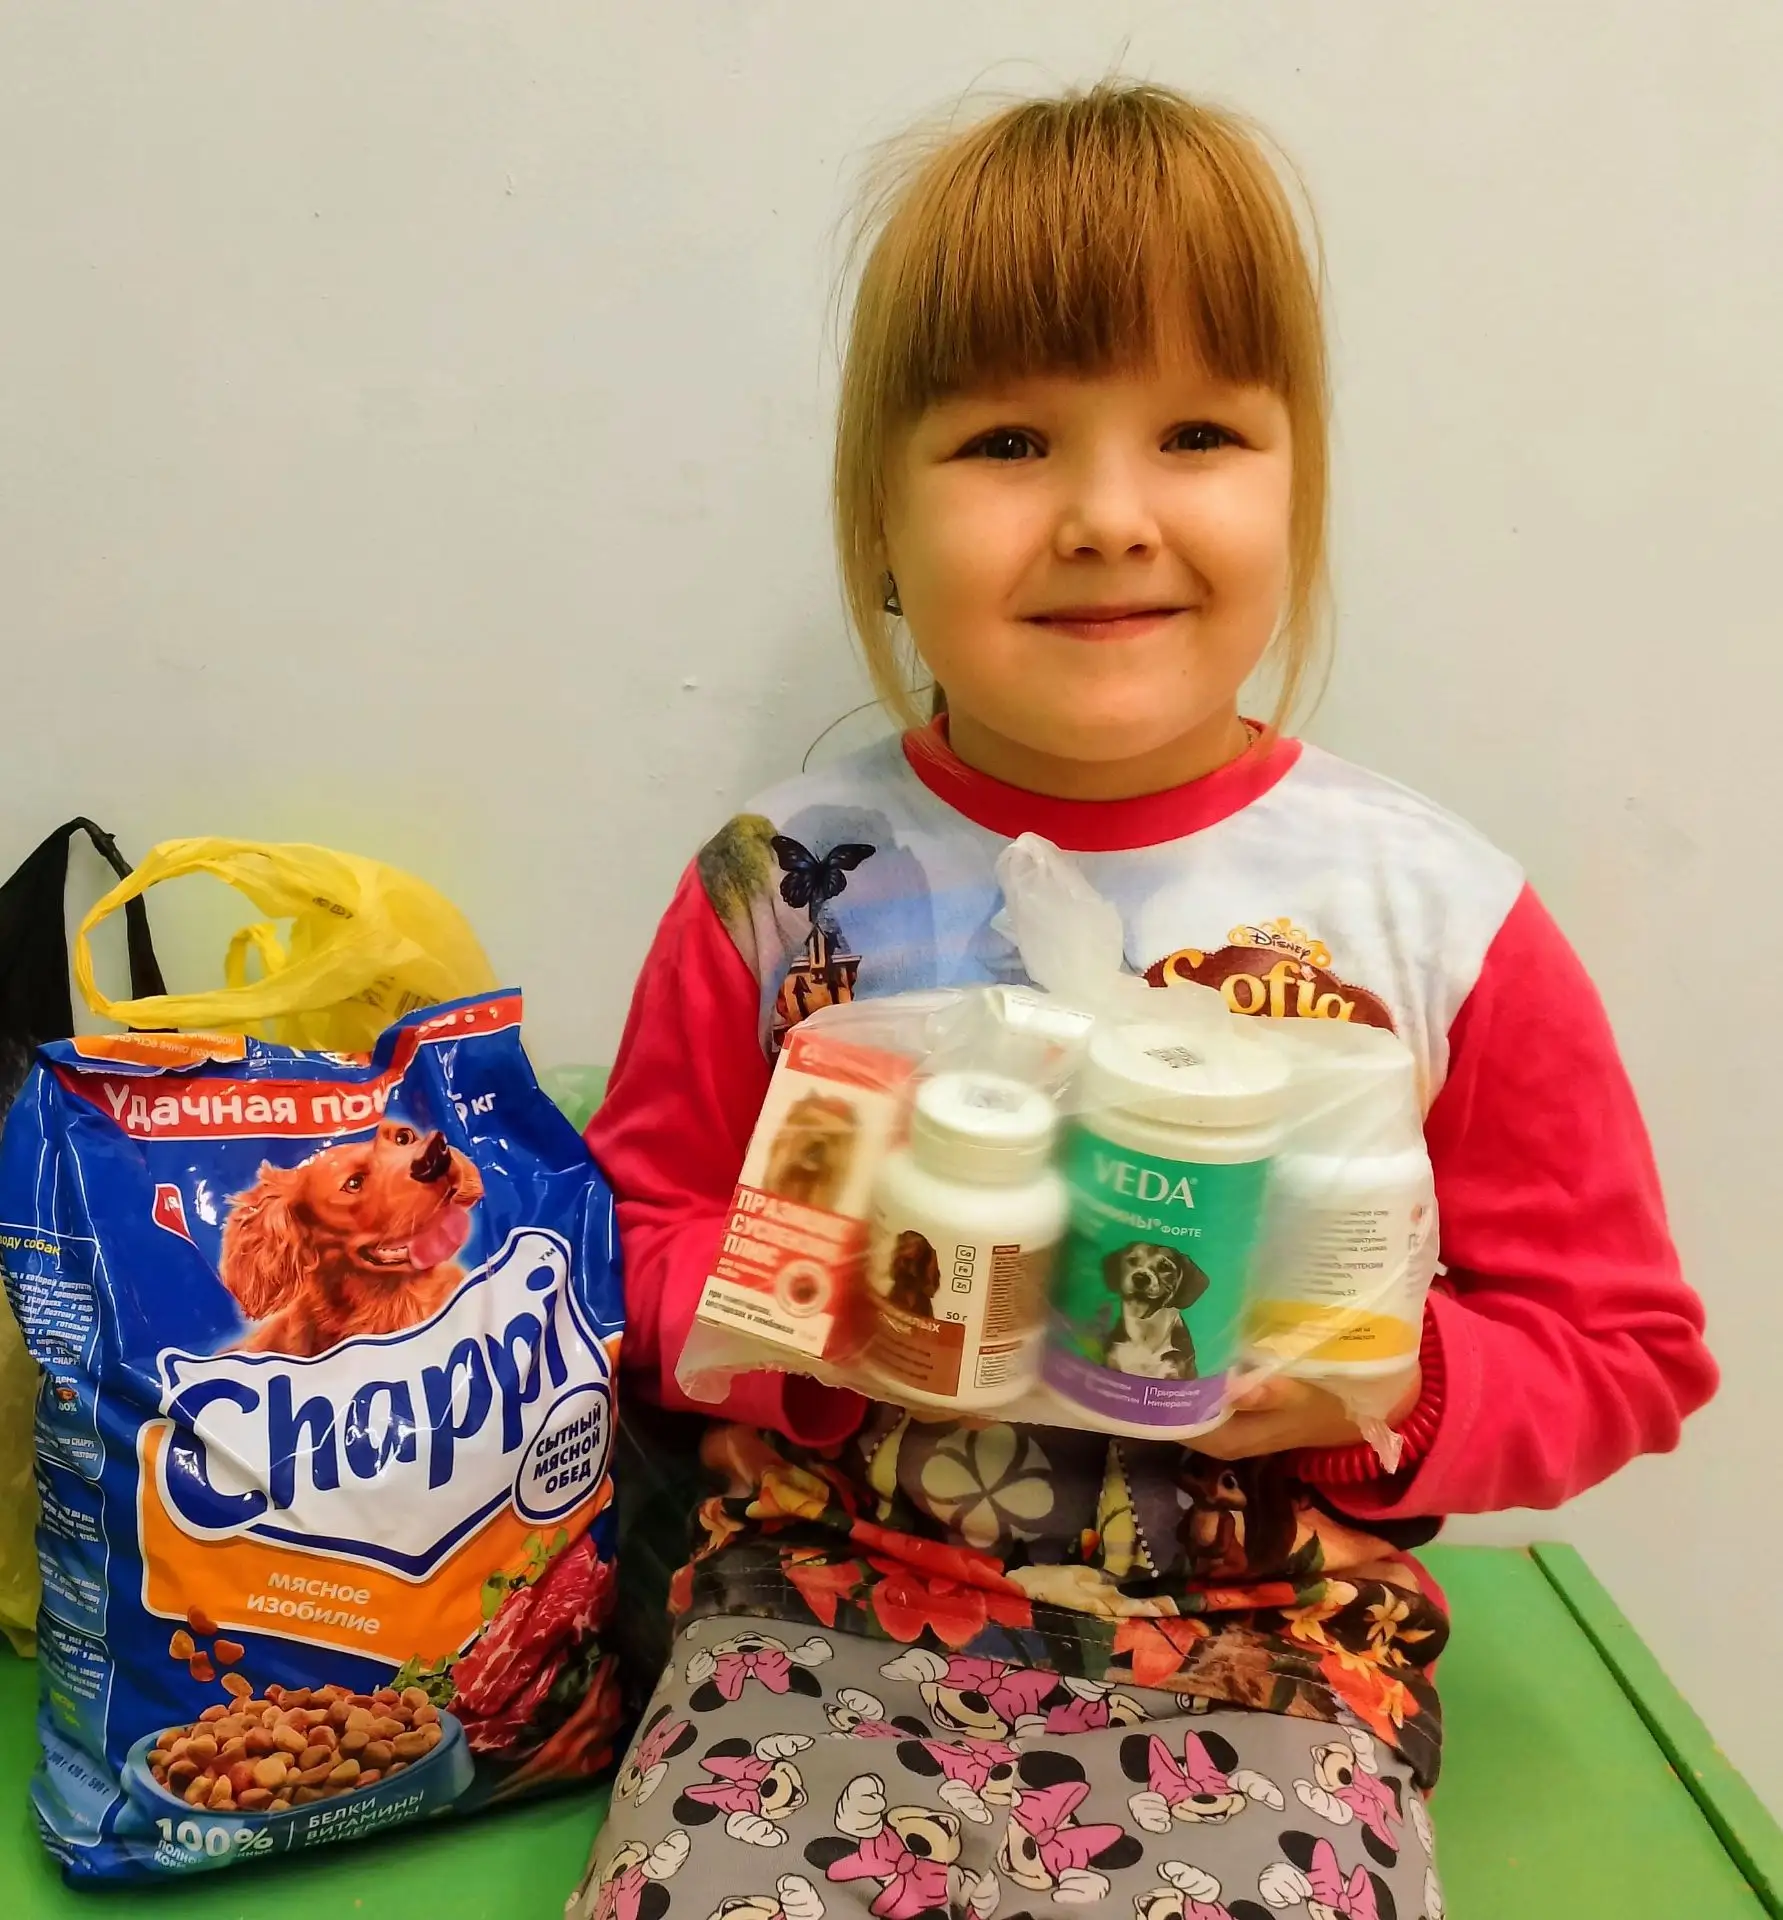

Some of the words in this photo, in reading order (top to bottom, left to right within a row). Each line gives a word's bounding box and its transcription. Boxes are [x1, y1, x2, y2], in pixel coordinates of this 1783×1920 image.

[103, 1083, 297, 1132] Удачная
[1094, 1152, 1195, 1209] VEDA
[1160, 1224, 1202, 1238] ФОРТЕ
[44, 1308, 77, 1320] Поэтому
[946, 1311, 960, 1321] 50
[55, 1375, 78, 1384] день
[165, 1264, 568, 1530] Chappi
[536, 1403, 602, 1458] СЫТНЫЙ
[532, 1427, 602, 1480] МЯСНОЙ
[545, 1458, 591, 1494] ОБЕД
[267, 1572, 371, 1604] мясное
[247, 1594, 380, 1634] изобилие
[307, 1789, 424, 1841] ВИТАМИНЫ
[309, 1797, 376, 1829] БЕЛКИ
[155, 1818, 274, 1857] 100%
